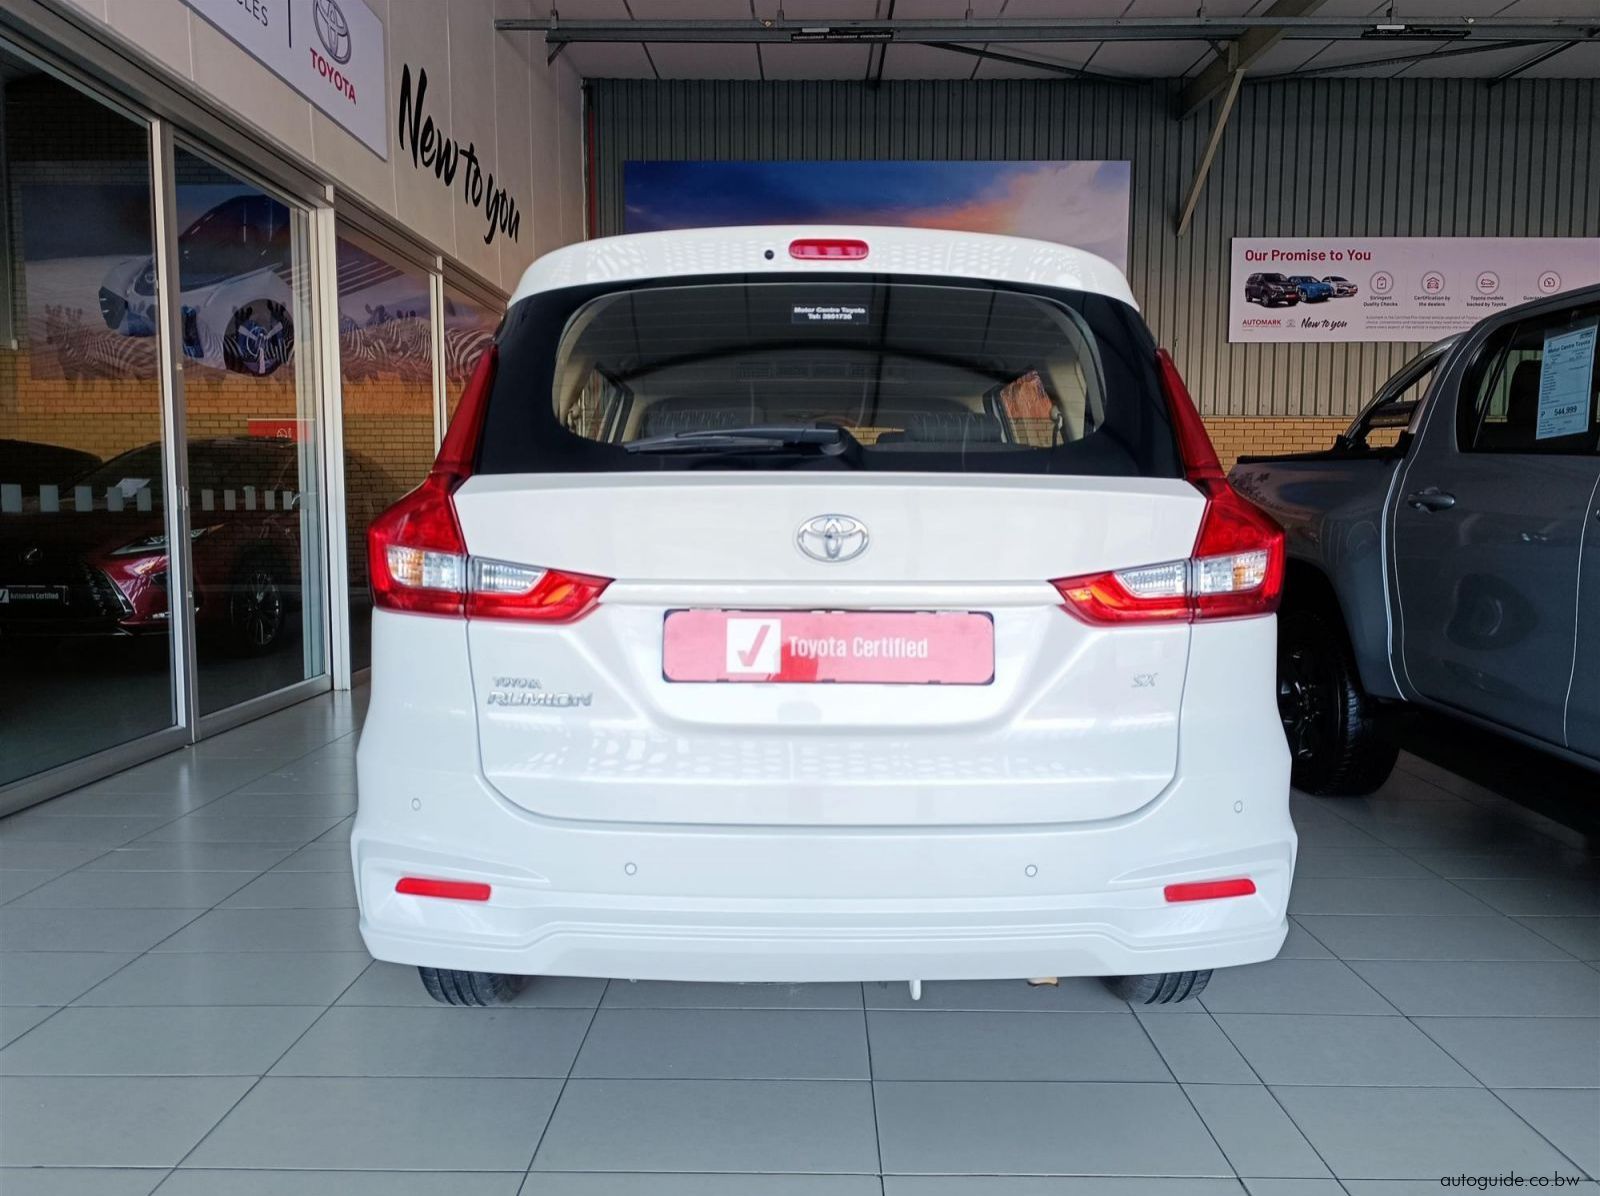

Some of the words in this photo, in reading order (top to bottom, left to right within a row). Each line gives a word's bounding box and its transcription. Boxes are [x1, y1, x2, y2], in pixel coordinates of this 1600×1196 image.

[310, 47, 357, 105] TOYOTA
[398, 63, 459, 187] New
[459, 142, 483, 208] to
[483, 173, 520, 245] you
[1245, 249, 1268, 261] Our
[1271, 249, 1326, 261] Promise
[1330, 249, 1343, 261] to
[1347, 249, 1371, 261] You
[793, 306, 815, 314] Motor
[815, 306, 841, 314] Centre
[840, 306, 866, 315] Toyota
[1300, 316, 1320, 328] New
[1320, 319, 1330, 328] to
[1330, 319, 1348, 331] you
[788, 635, 847, 659] Toyota
[852, 636, 928, 659] Certified
[492, 676, 542, 689] TOYOTA
[487, 690, 593, 707] RUMION
